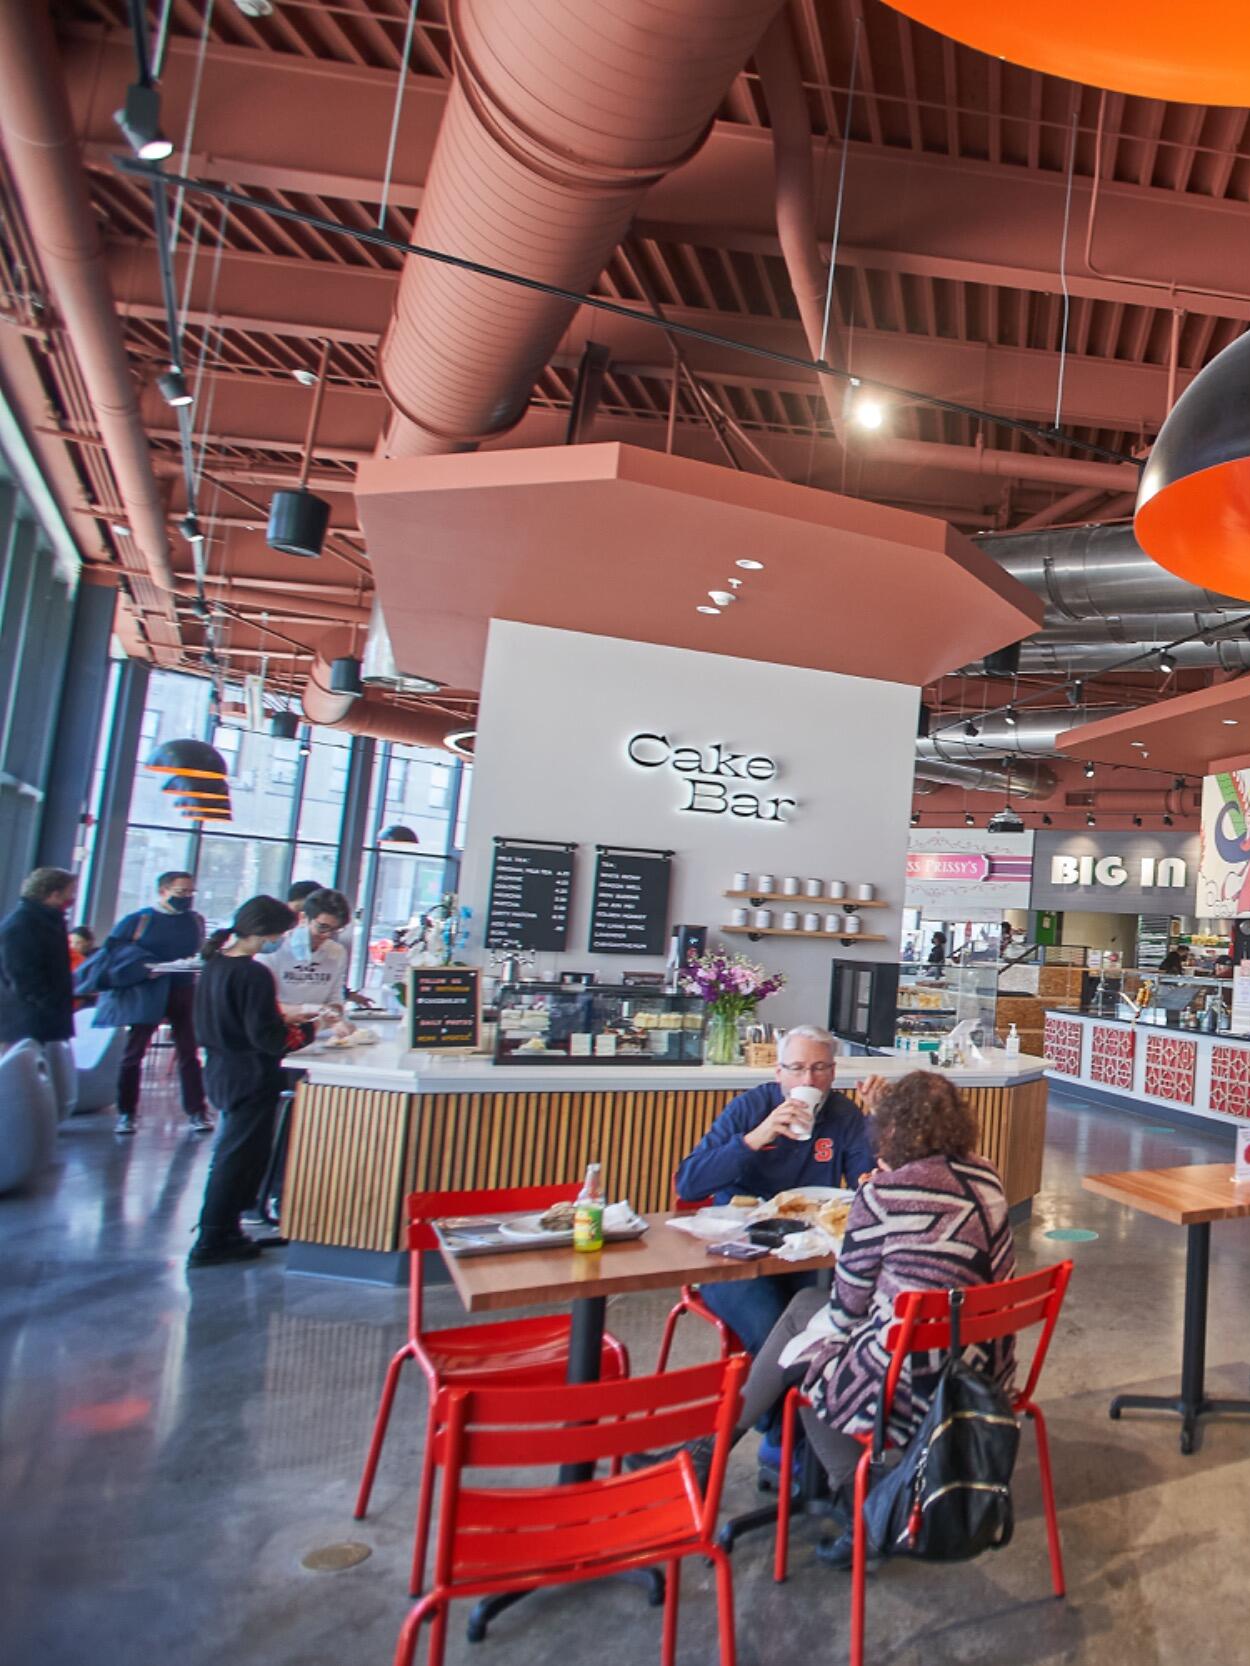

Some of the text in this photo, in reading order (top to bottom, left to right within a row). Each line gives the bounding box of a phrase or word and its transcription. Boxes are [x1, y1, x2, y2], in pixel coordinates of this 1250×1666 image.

[628, 733, 776, 781] Cake
[680, 778, 796, 822] Bar
[925, 860, 978, 875] PRISSY'S
[1051, 856, 1187, 888] BIG IN
[815, 1137, 833, 1162] S
